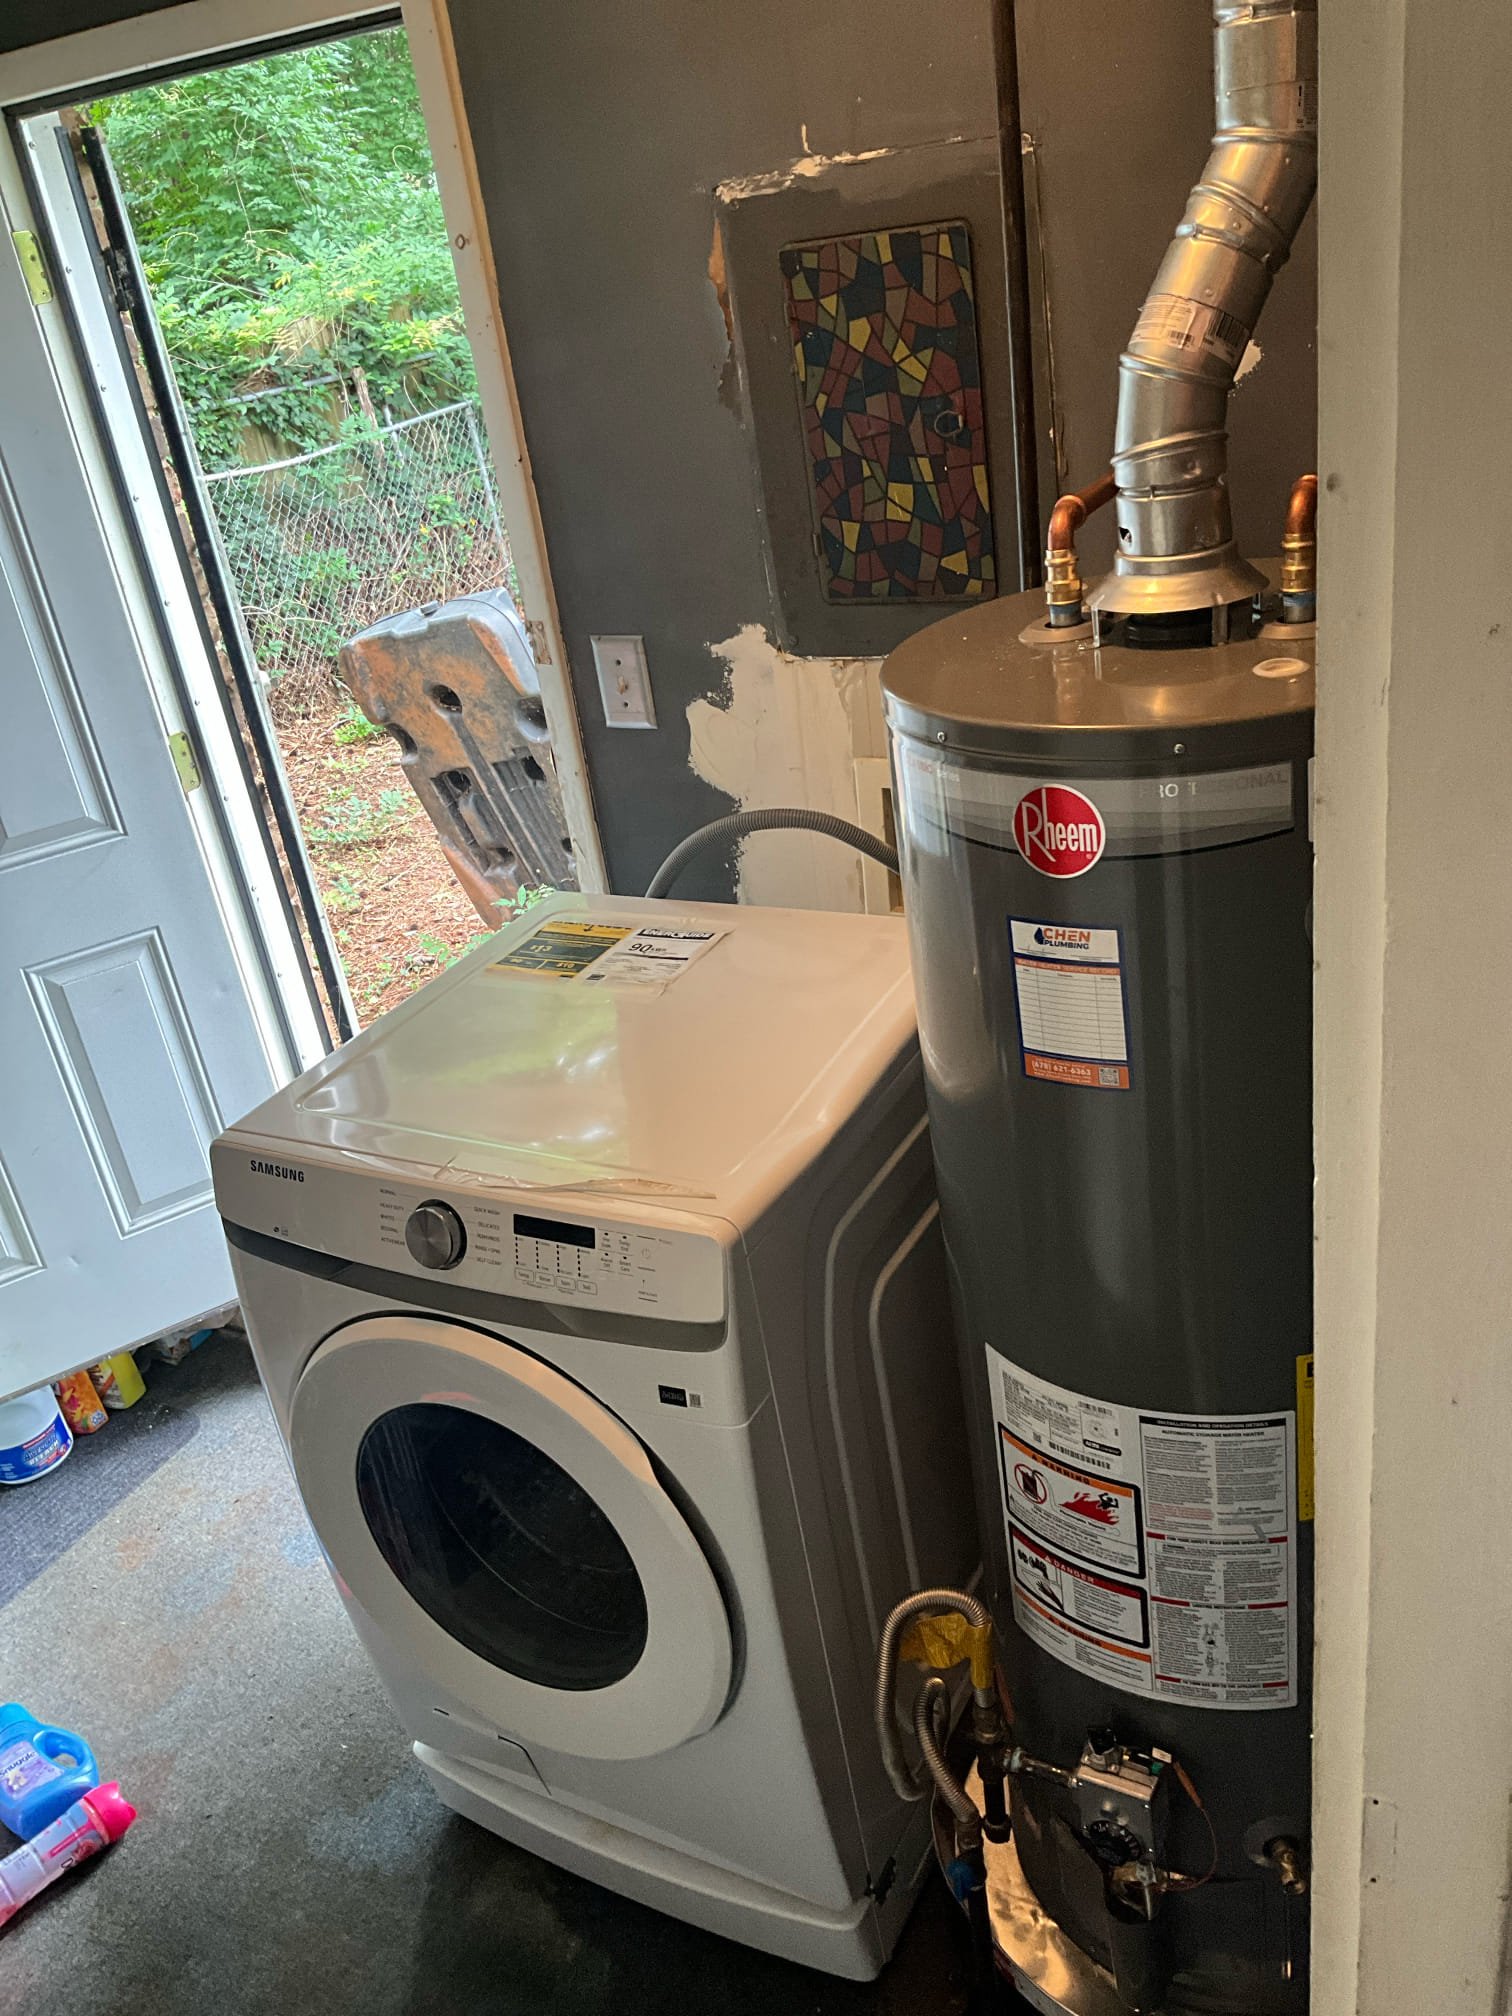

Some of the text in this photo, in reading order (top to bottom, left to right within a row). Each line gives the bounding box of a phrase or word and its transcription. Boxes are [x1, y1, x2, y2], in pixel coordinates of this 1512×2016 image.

[1020, 787, 1099, 863] Rheem
[628, 942, 654, 954] 90
[1043, 927, 1092, 943] CHEN
[1043, 939, 1090, 950] PLUMBING
[250, 1159, 305, 1183] SAMSUNG
[1042, 1458, 1091, 1486] WARNING
[1054, 1558, 1096, 1584] DANGER
[1059, 1617, 1104, 1647] WARNING
[0, 1751, 36, 1777] Snuggle
